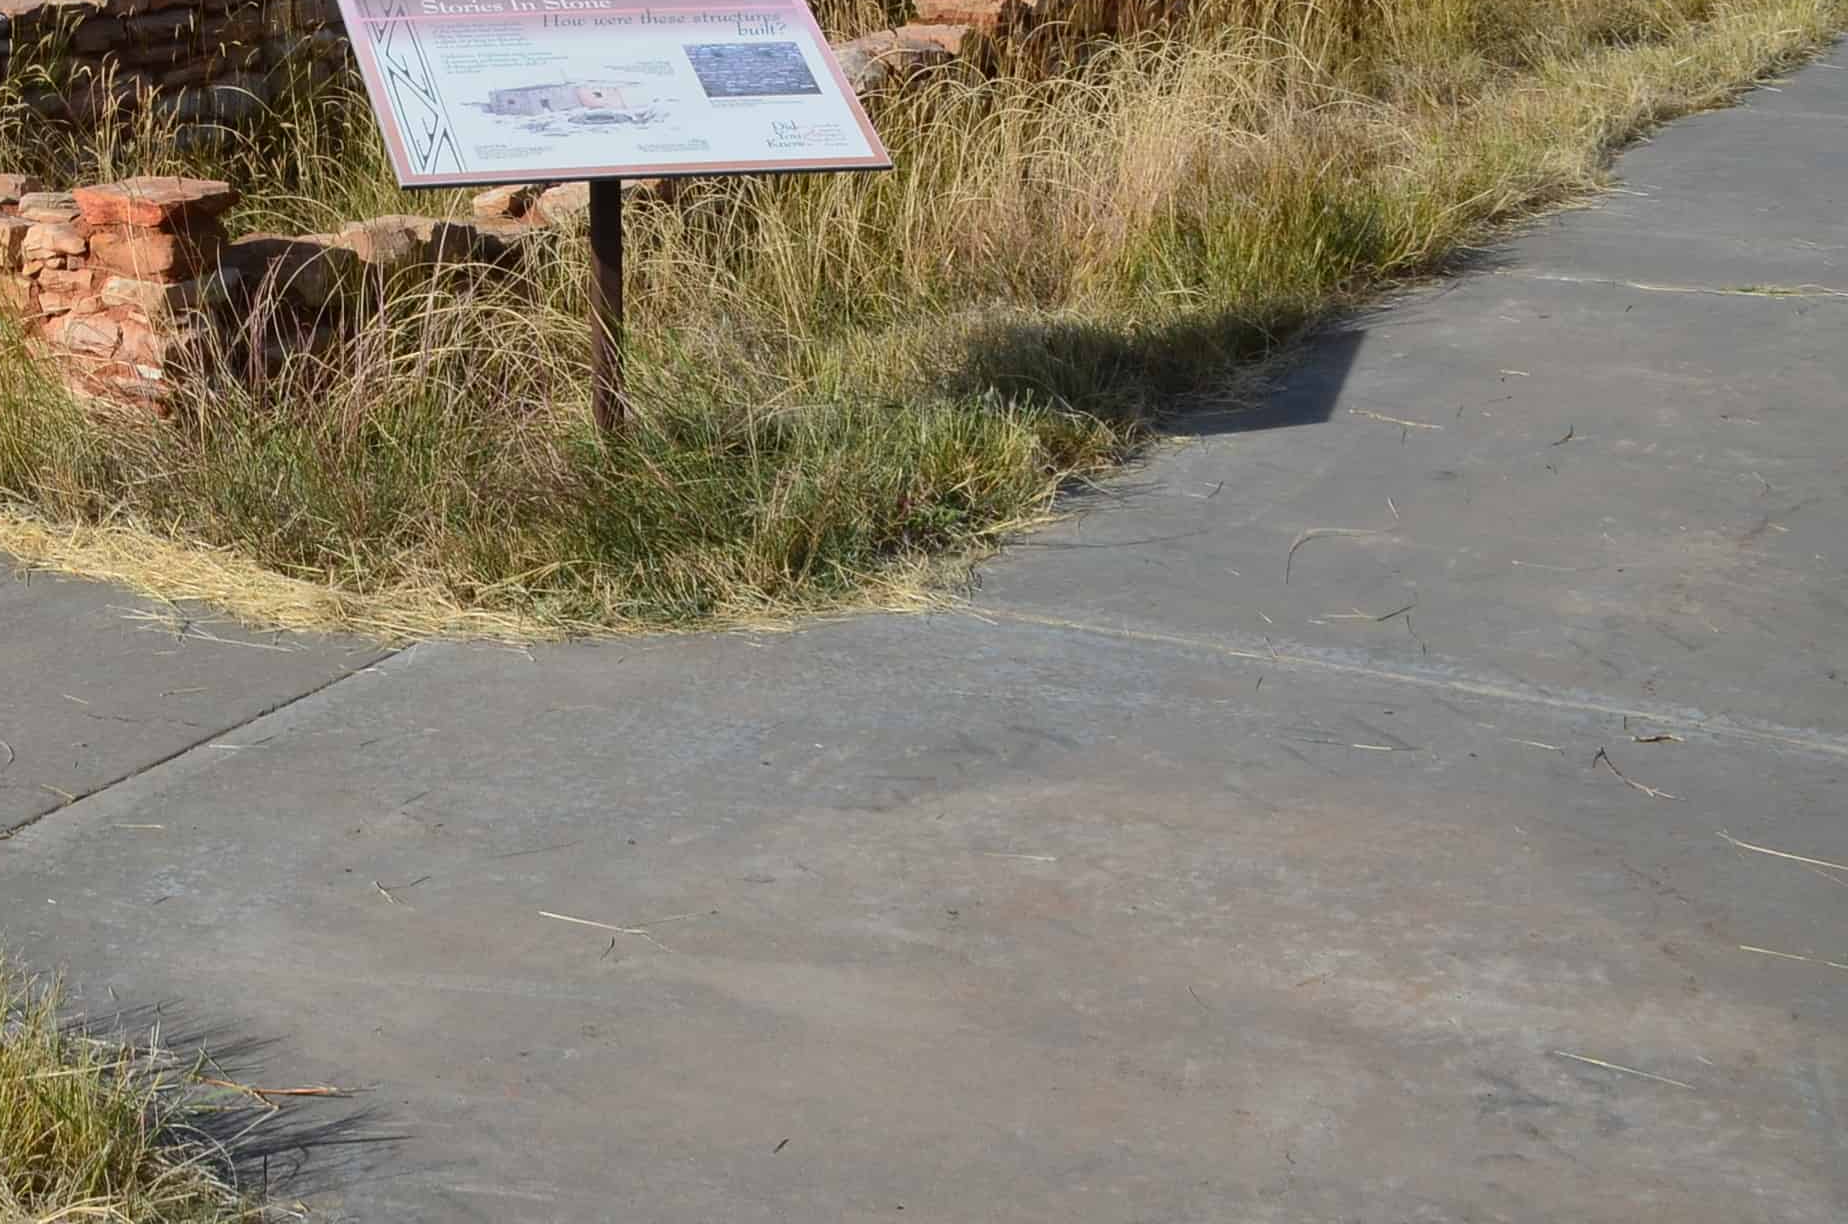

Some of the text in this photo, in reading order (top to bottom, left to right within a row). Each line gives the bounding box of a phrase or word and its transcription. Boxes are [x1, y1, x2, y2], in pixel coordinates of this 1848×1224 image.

[543, 9, 780, 28] How were these structures
[736, 21, 786, 36] built?
